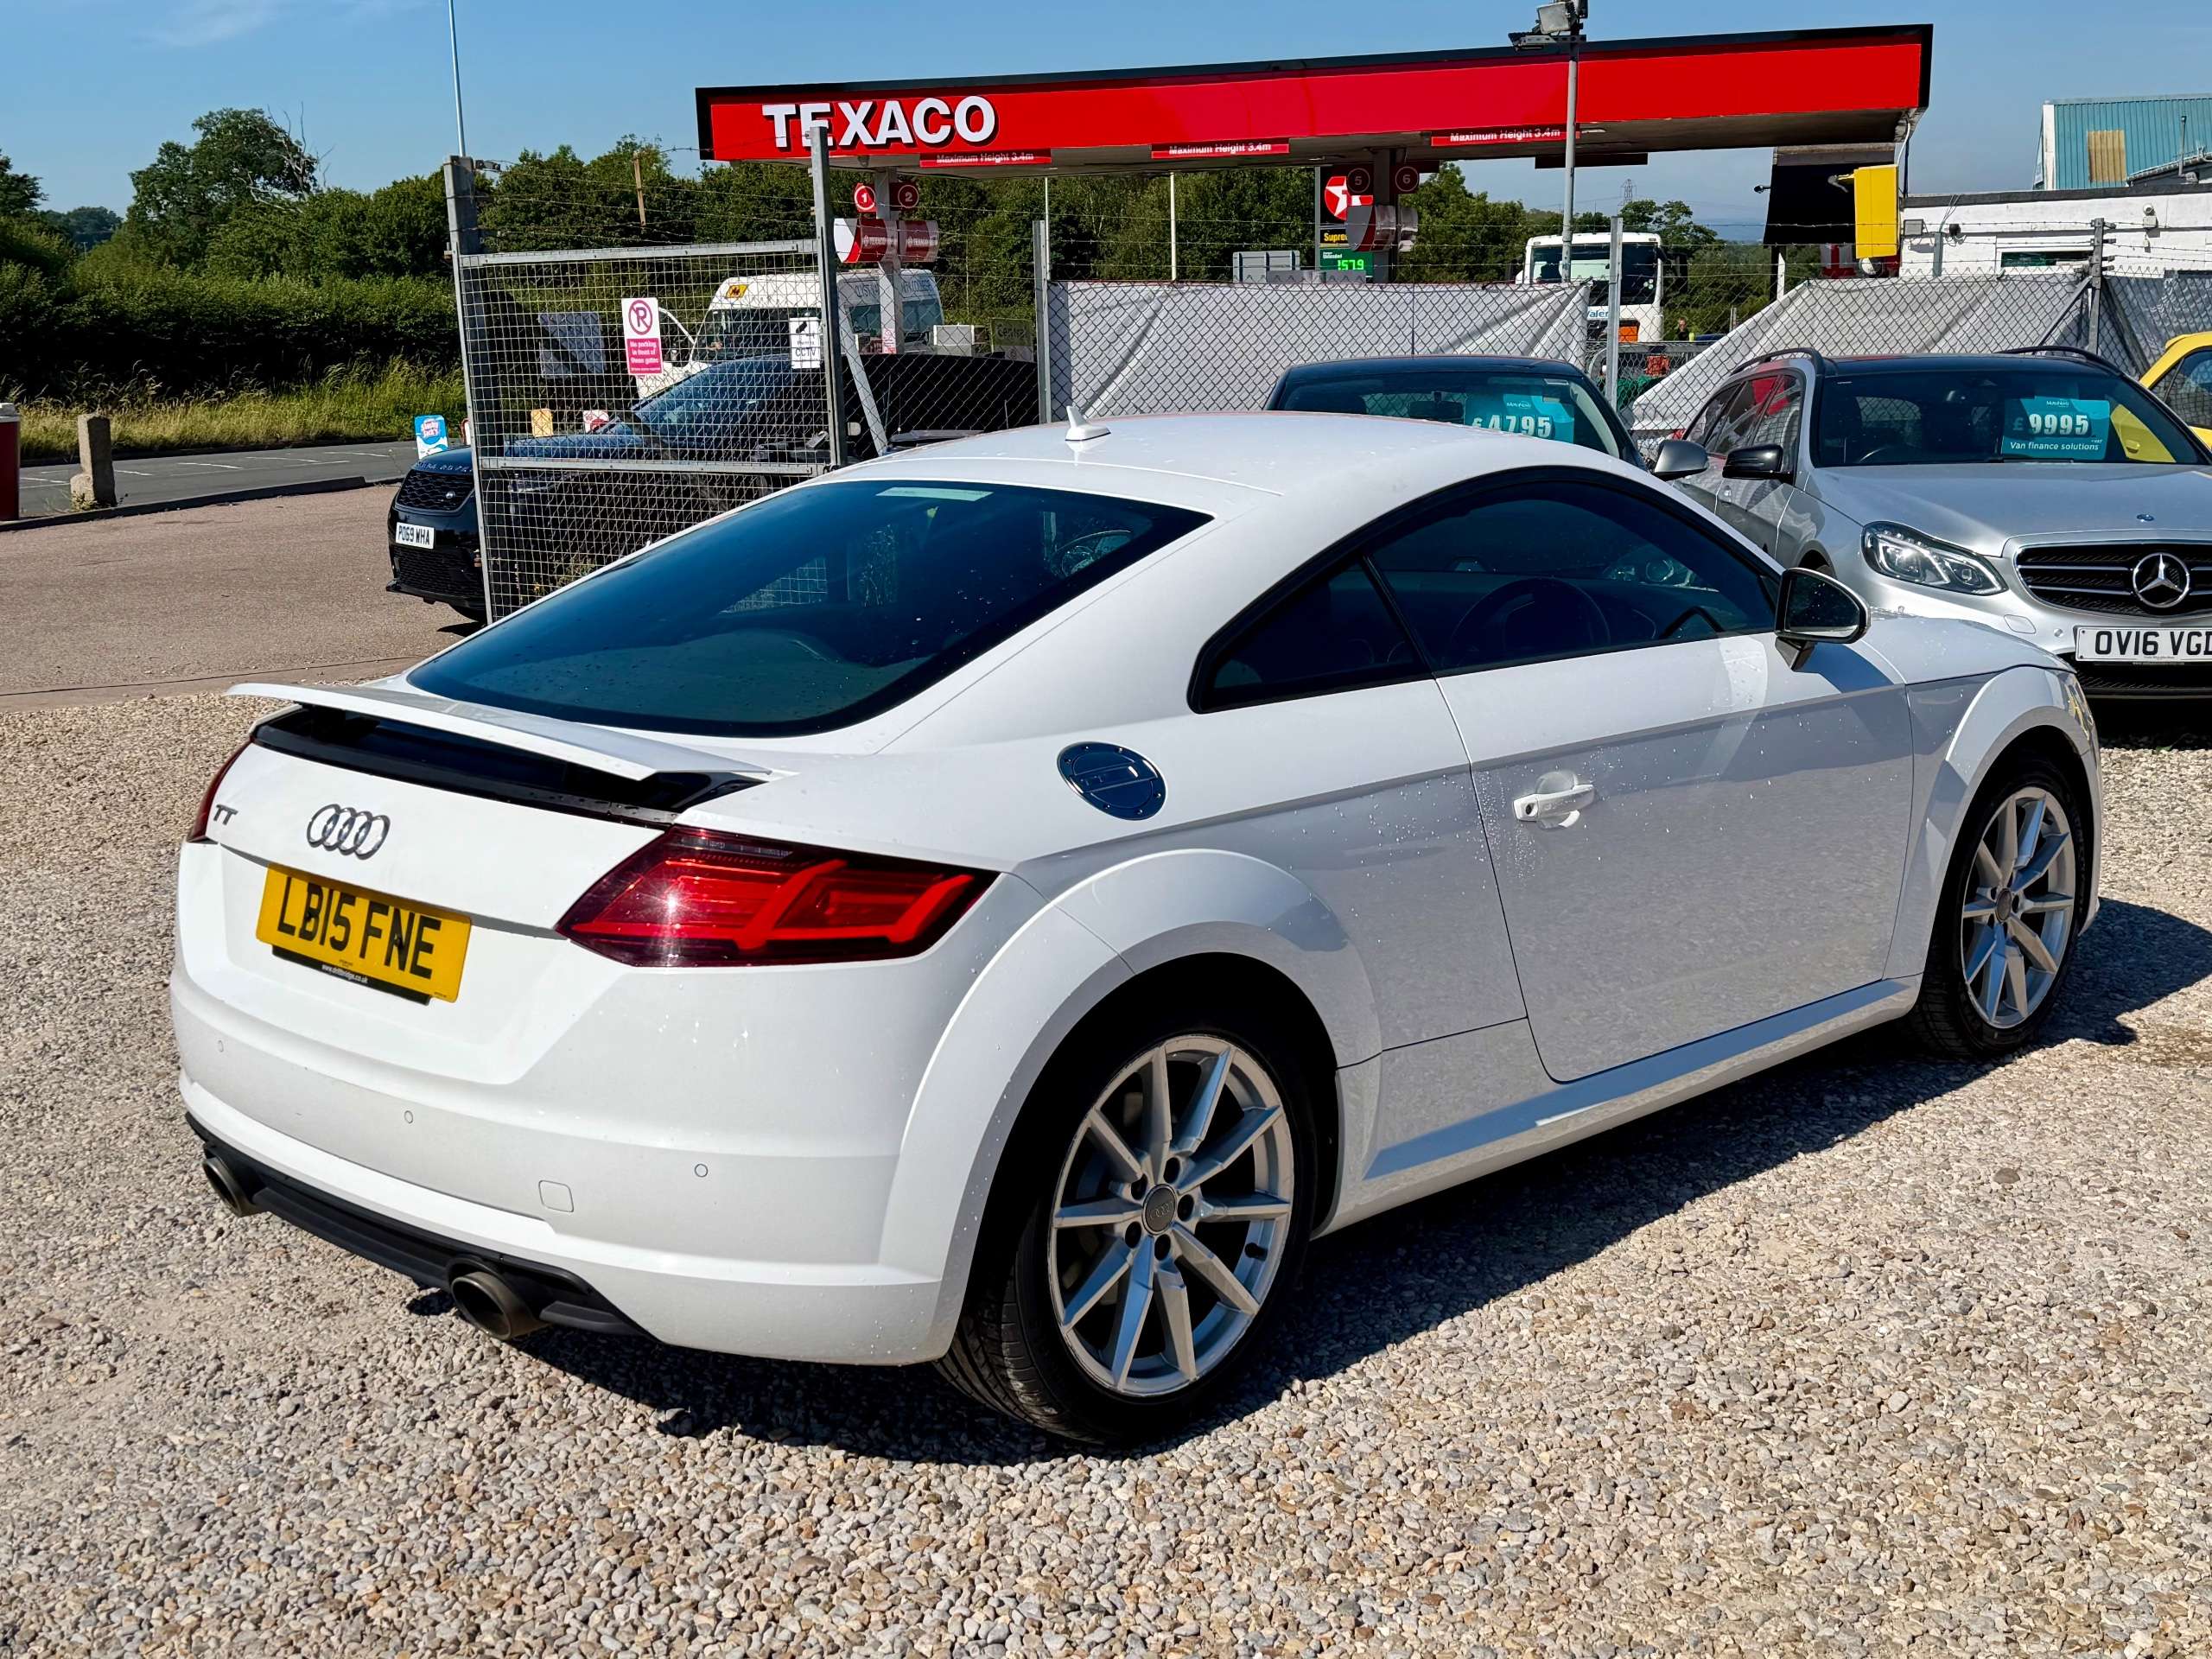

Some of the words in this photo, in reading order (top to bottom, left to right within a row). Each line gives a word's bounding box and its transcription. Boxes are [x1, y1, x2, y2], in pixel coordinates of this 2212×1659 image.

[761, 95, 995, 149] TEXACO
[1449, 132, 1497, 143] Maximum
[1499, 130, 1533, 141] Height
[1534, 128, 1560, 137] 3.4m
[1169, 145, 1213, 155] Maximum
[1215, 143, 1246, 154] Height
[1248, 142, 1272, 151] 3.4m
[937, 154, 978, 163] Maximum
[981, 151, 1010, 163] Height
[1012, 151, 1034, 161] 3.4m
[1354, 175, 1363, 186] 5
[1402, 175, 1411, 184] 6
[861, 192, 869, 203] 1
[904, 191, 913, 202] 2
[1324, 232, 1348, 243] Supre
[795, 347, 816, 357] CCTV
[416, 527, 430, 545] WHA
[2094, 630, 2160, 656] OV16
[213, 804, 238, 825] TT
[276, 876, 356, 951] LB15
[359, 899, 442, 980] FNE
